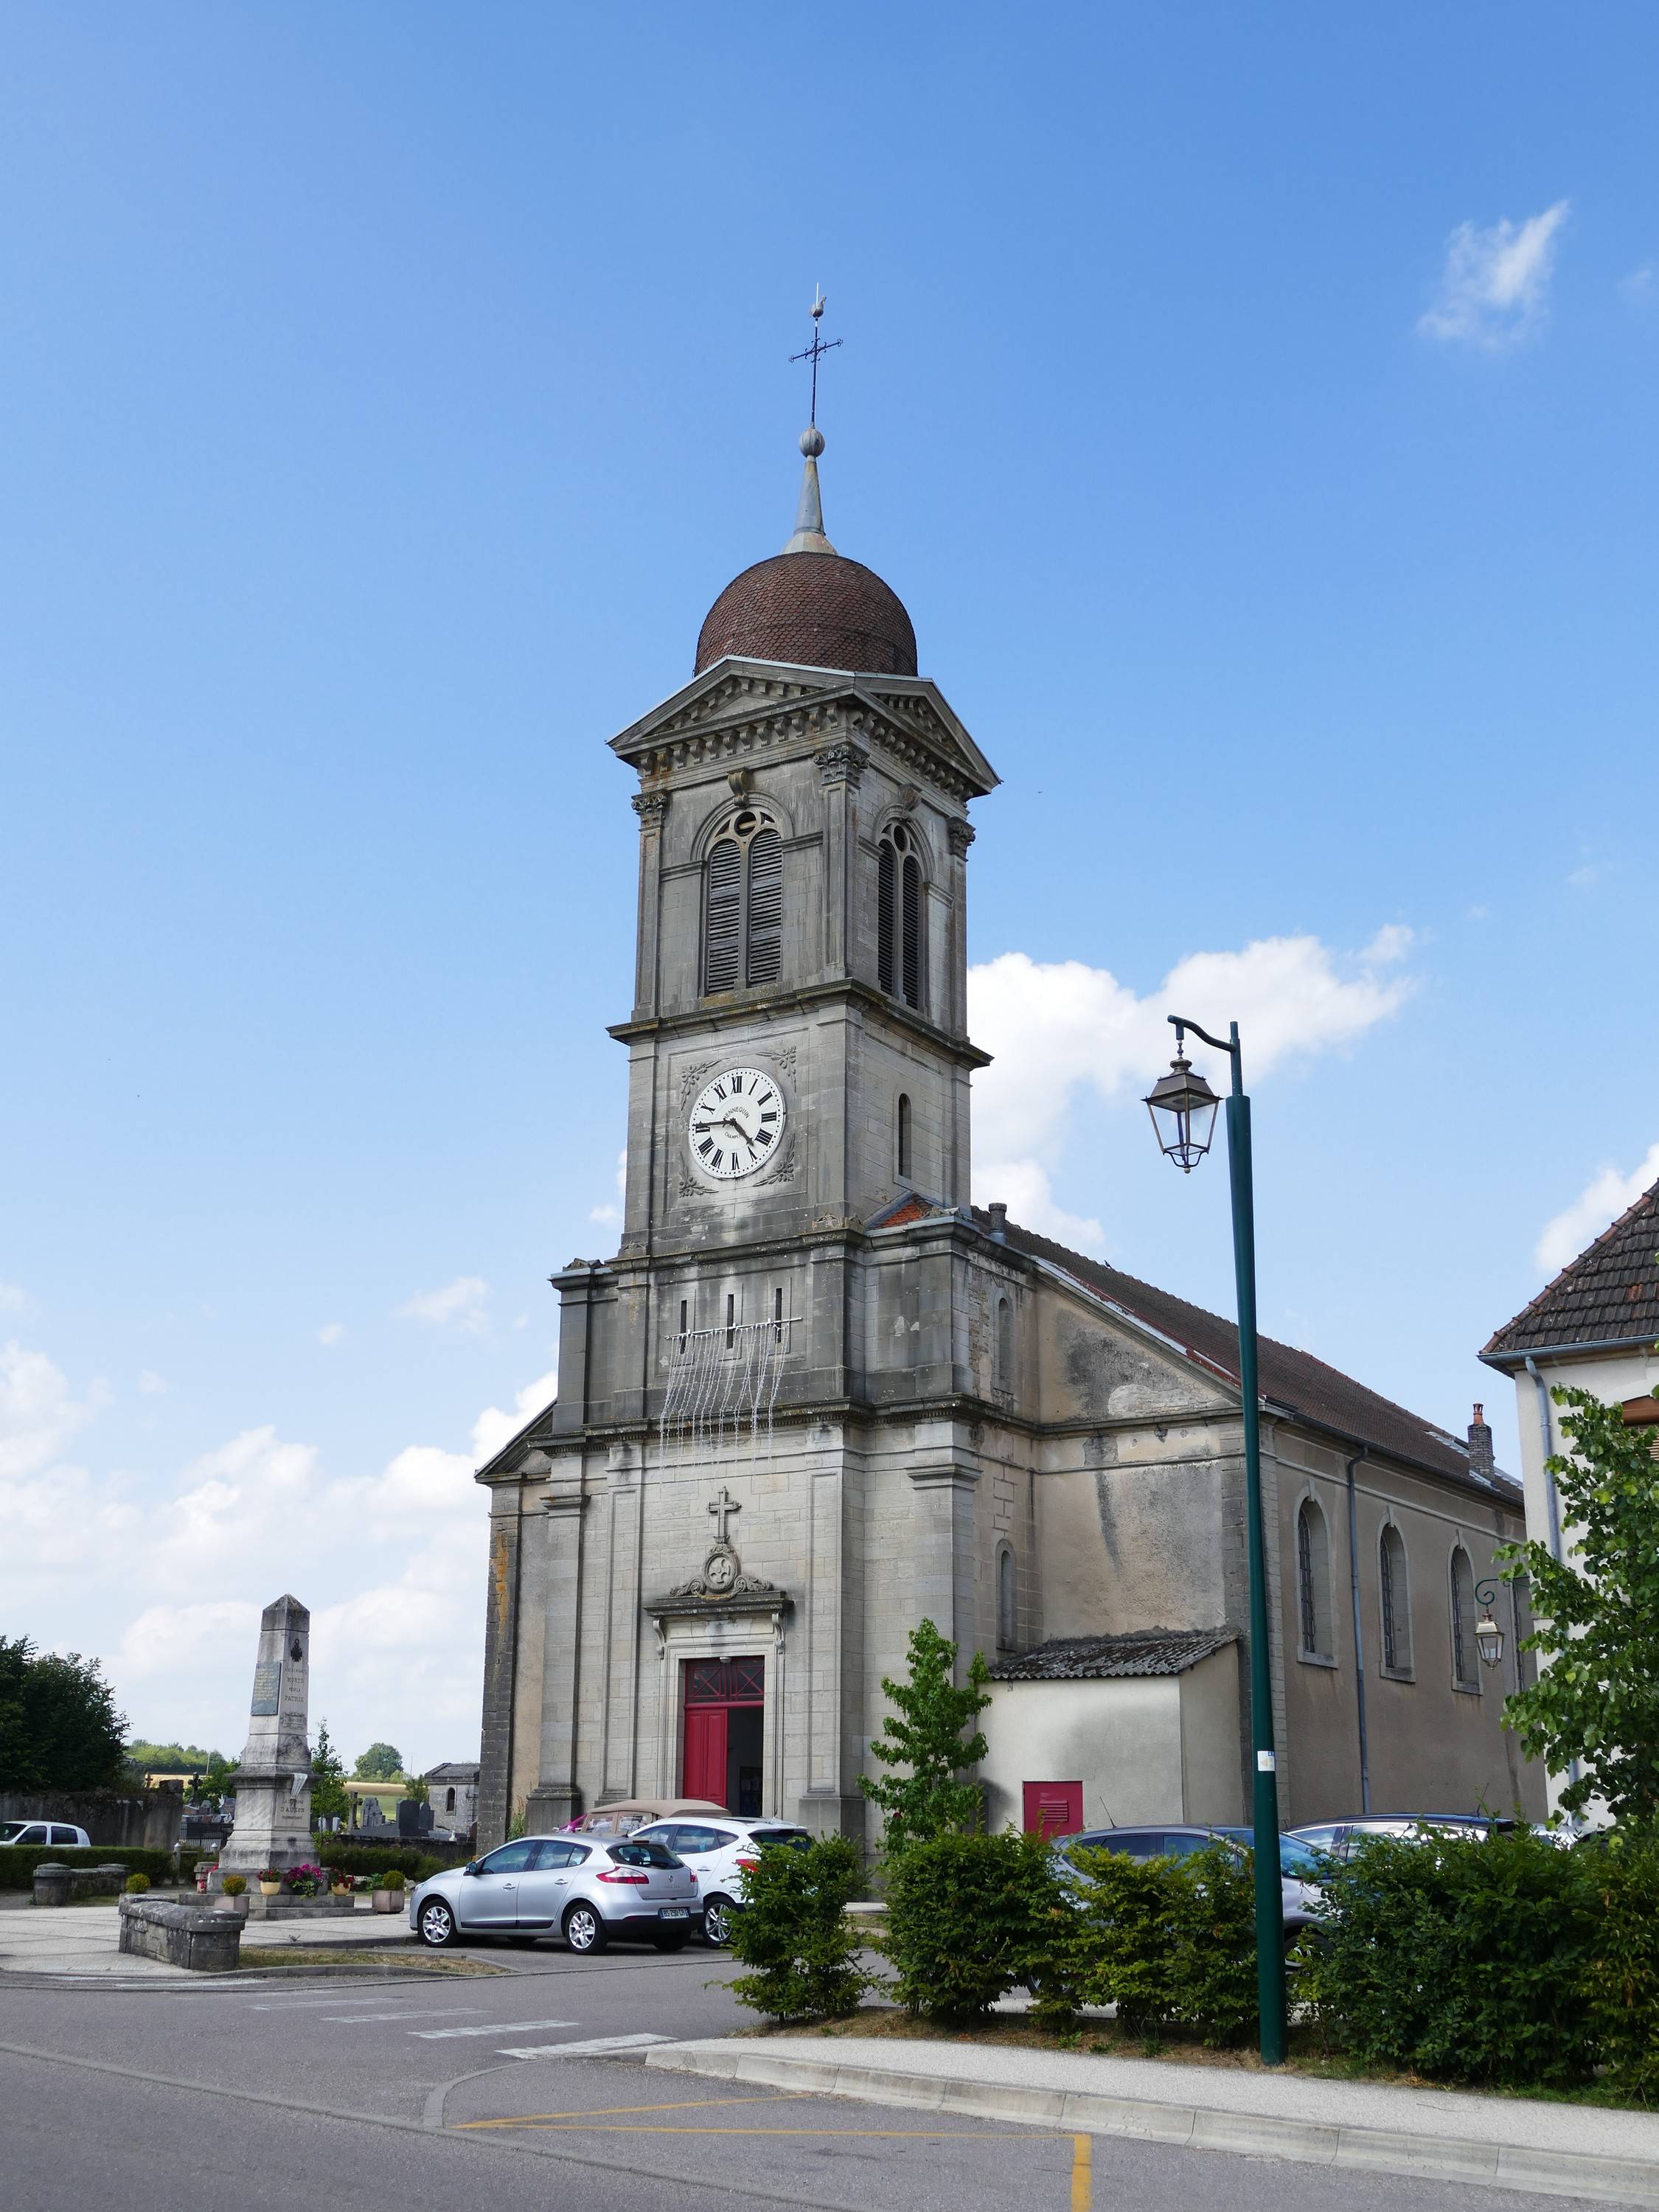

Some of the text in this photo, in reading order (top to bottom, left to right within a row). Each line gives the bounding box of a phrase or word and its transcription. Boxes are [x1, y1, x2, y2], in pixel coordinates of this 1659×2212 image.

[714, 1083, 727, 1102] XI
[731, 1076, 742, 1094] XII
[748, 1079, 758, 1096] I
[757, 1091, 773, 1107] II
[700, 1102, 715, 1115] X
[723, 1106, 750, 1119] HENNEQUIN
[761, 1111, 776, 1123] III
[754, 1128, 773, 1146] IIII
[698, 1136, 715, 1158] VIII
[748, 1146, 758, 1162] V
[711, 1148, 723, 1169] VII
[731, 1152, 740, 1170] VI
